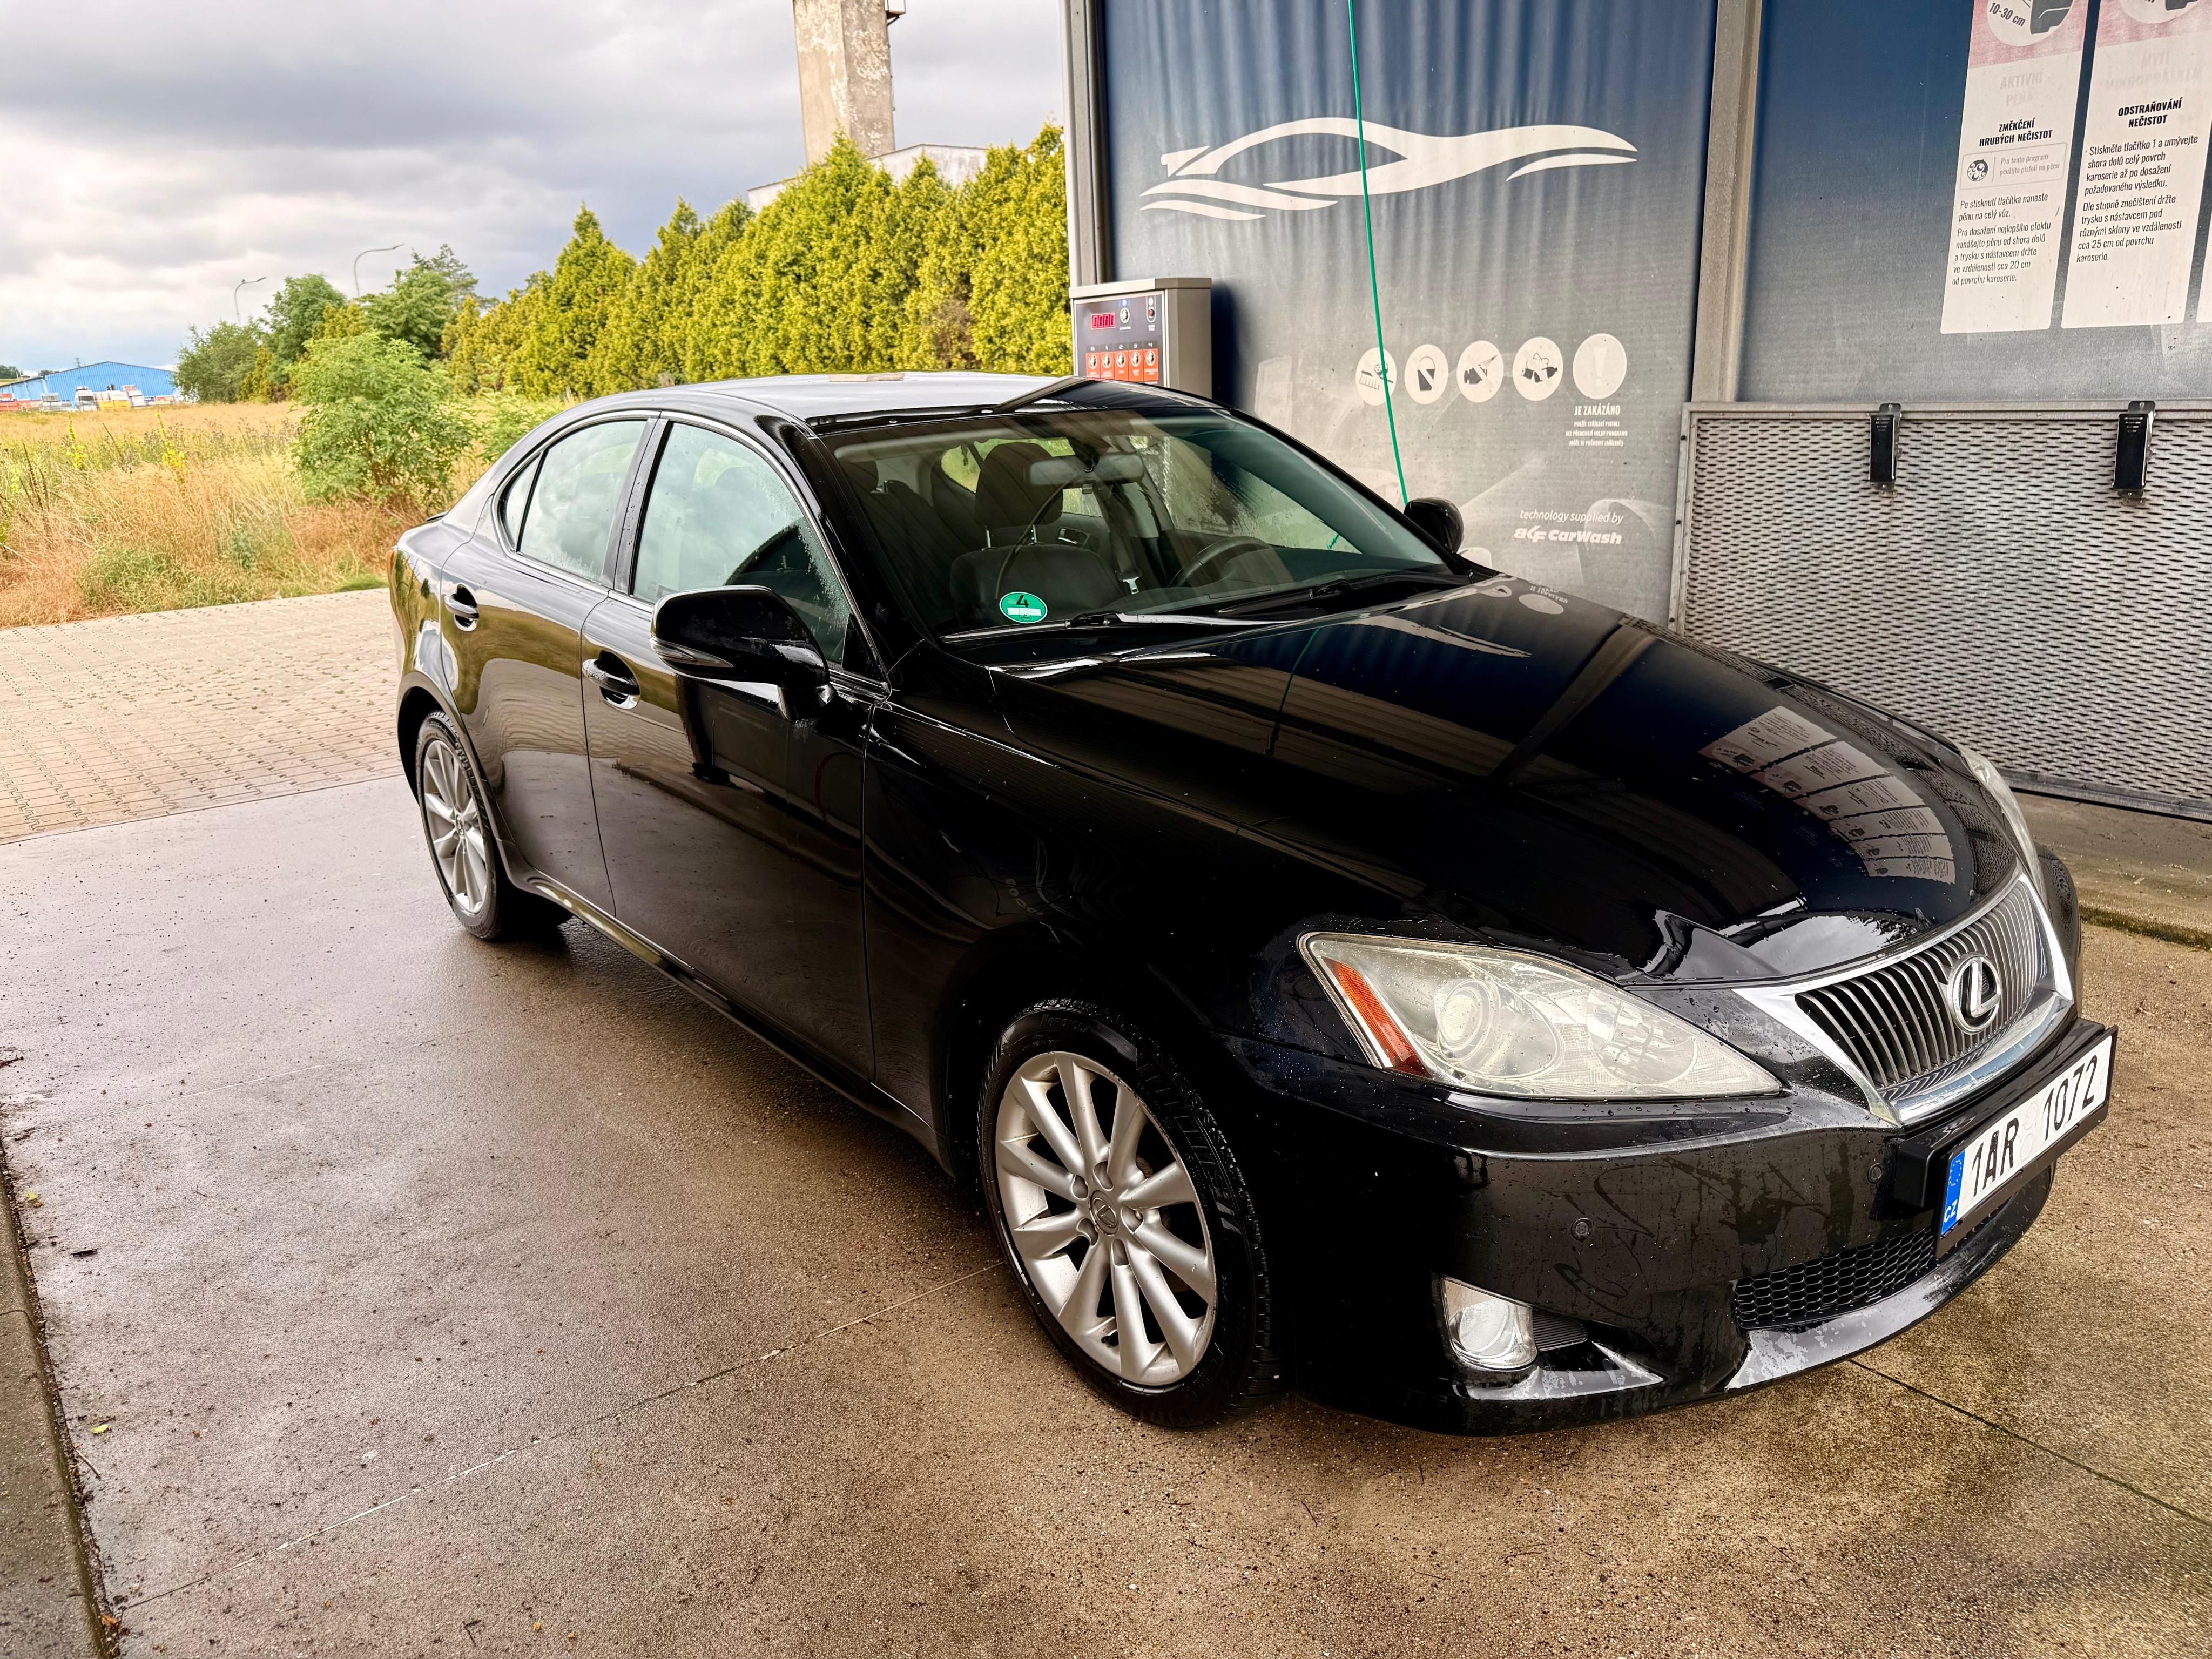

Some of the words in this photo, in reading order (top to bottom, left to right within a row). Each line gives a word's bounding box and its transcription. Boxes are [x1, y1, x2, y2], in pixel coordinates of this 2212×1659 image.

[1989, 2, 2013, 20] 10-30
[2012, 16, 2026, 27] cm
[2118, 97, 2183, 116] ODSTRAŇOVÁNÍ
[1999, 117, 2035, 132] ZMĚKČENÍ
[2128, 115, 2167, 127] NEČISTOT
[1979, 133, 2014, 147] HRUBÝCH
[2018, 130, 2053, 142] NEČISTOT
[2089, 144, 2122, 156] Stiskněte
[2124, 140, 2150, 151] tlačítko
[2153, 139, 2155, 148] 1
[2164, 136, 2198, 147] umývejte
[2088, 159, 2107, 168] shora
[2109, 156, 2123, 166] dolů
[2125, 154, 2140, 165] celý
[2141, 152, 2166, 165] povrch
[2087, 171, 2117, 181] karoserie
[2120, 169, 2127, 178] až
[2129, 170, 2138, 179] po
[2140, 164, 2171, 176] dosažení
[2085, 183, 2132, 197] požadovaného
[2135, 178, 2167, 190] výsledku.
[1960, 200, 1968, 209] Po
[1970, 197, 1997, 208] stisknutí
[1998, 195, 2021, 205] tlačítka
[2023, 193, 2048, 203] naneste
[2083, 202, 2094, 211] Dle
[2096, 200, 2119, 211] stupně
[2158, 194, 2176, 204] držte
[1959, 213, 1973, 222] pěnu
[1984, 209, 1997, 219] celý
[1999, 208, 2011, 217] vůz.
[2082, 214, 2102, 225] trysku
[2110, 211, 2147, 221] nástavcem
[2149, 208, 2163, 219] pod
[1957, 228, 1967, 237] Pro
[1970, 225, 1997, 235] dosažení
[2031, 222, 2051, 231] efektu
[2080, 226, 2106, 237] různými
[2108, 225, 2130, 235] sklony
[2142, 220, 2182, 232] vzdálenosti
[1986, 238, 2001, 248] pěnu
[2003, 237, 2011, 245] od
[2013, 235, 2029, 245] shora
[2032, 233, 2045, 242] dolů
[2092, 240, 2101, 248] 25
[2115, 238, 2124, 246] od
[2126, 236, 2154, 248] povrchu
[1960, 252, 1979, 262] trysku
[1986, 249, 2019, 259] nástavcem
[2021, 248, 2037, 257] držte
[2076, 253, 2109, 262] karoserie.
[1962, 262, 1995, 273] vzdálenosti
[2010, 260, 2019, 269] 20
[1961, 275, 1985, 286] povrchu
[1574, 406, 1582, 416] JE
[1583, 402, 1620, 415] ZAKÁZÁNO
[1520, 509, 1569, 523] technology
[1570, 511, 1610, 523] supplied
[1611, 512, 1624, 525] by
[1548, 530, 1622, 544] CarWash
[1016, 595, 1029, 608] 4
[1972, 1118, 2019, 1197] 1AR
[2043, 1055, 2098, 1141] 1072
[1944, 1199, 1958, 1223] CZ
